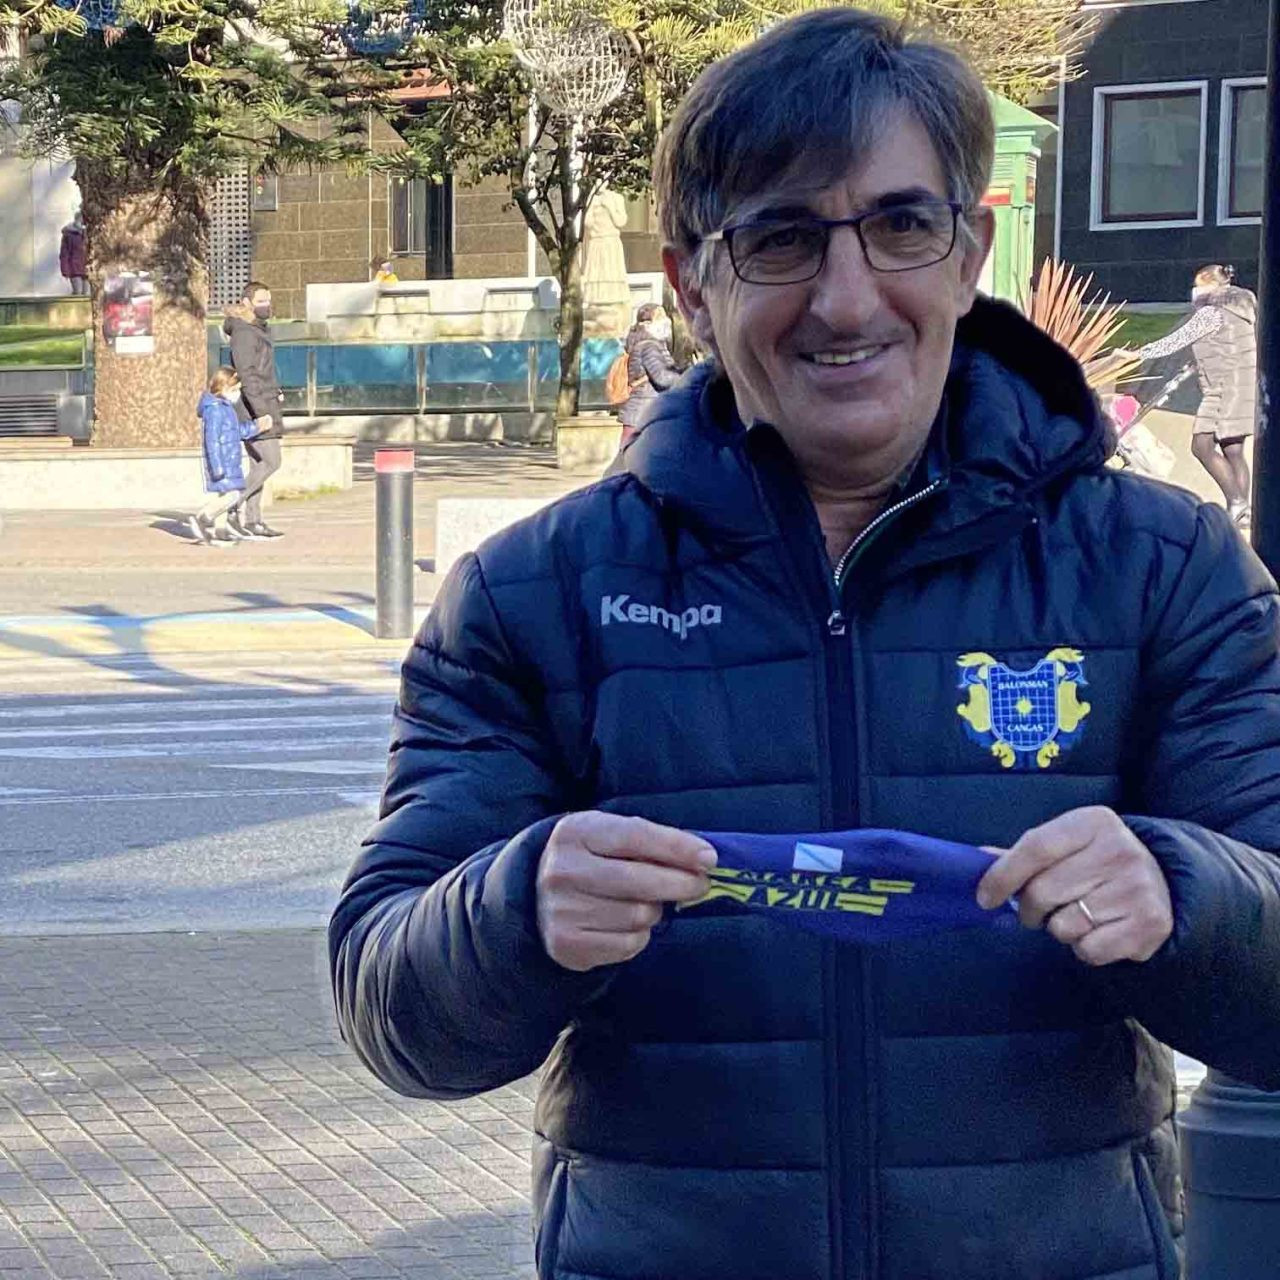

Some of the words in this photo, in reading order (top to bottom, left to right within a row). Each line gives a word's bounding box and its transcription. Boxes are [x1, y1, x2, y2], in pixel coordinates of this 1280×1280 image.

[601, 594, 722, 640] Kempa
[1007, 724, 1044, 733] CANGAS
[746, 886, 844, 912] AZUL
